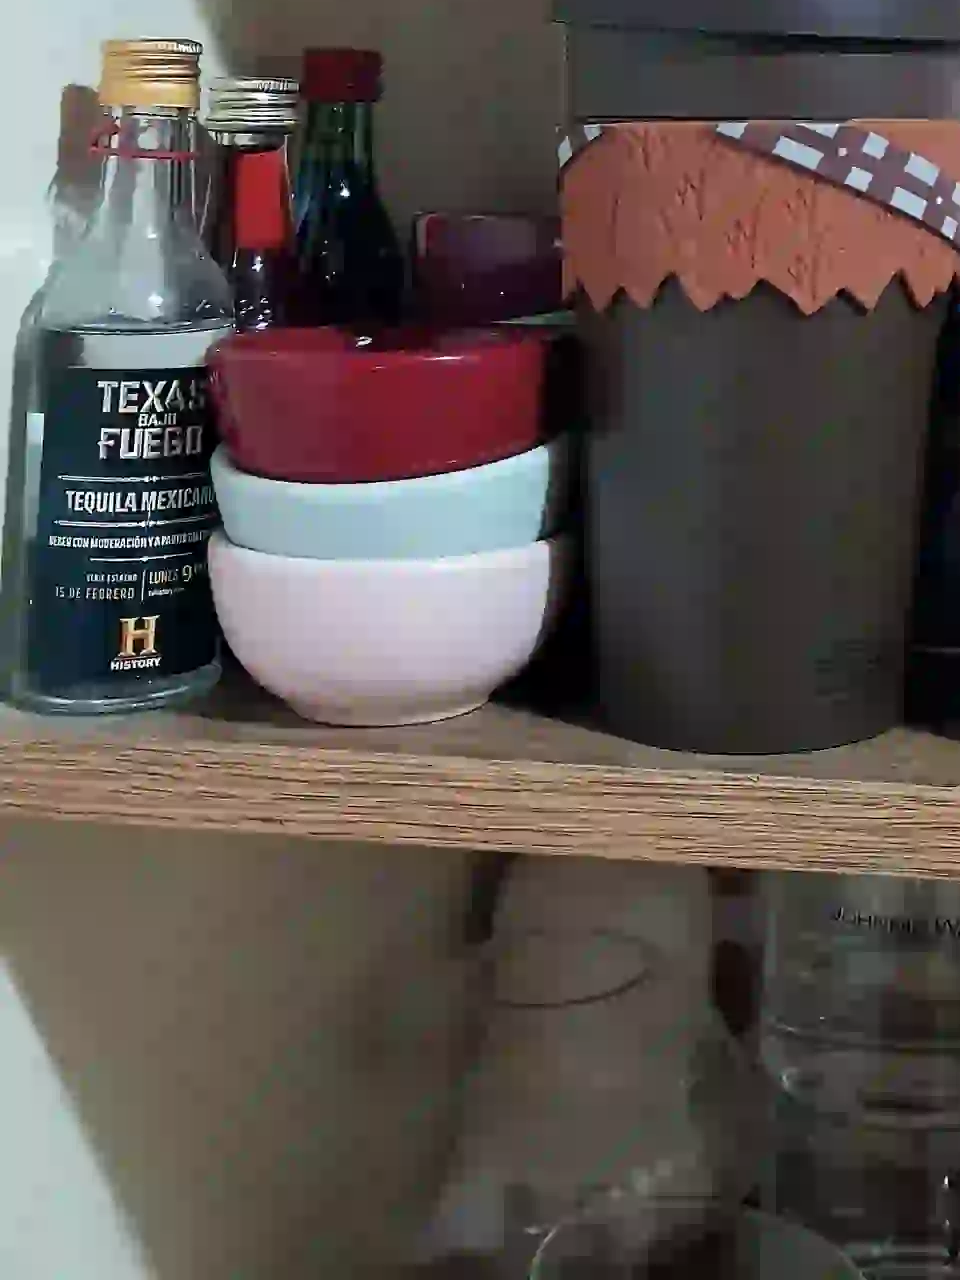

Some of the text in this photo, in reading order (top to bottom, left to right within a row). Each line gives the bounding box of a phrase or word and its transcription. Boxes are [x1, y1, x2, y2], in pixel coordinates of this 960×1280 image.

[97, 380, 207, 413] TEXAS
[138, 413, 177, 427] BAJO
[97, 427, 203, 460] FUEGO
[65, 489, 137, 514] TEQUILA
[69, 587, 81, 599] DE
[118, 615, 160, 656] H
[110, 657, 163, 671] HISTORY
